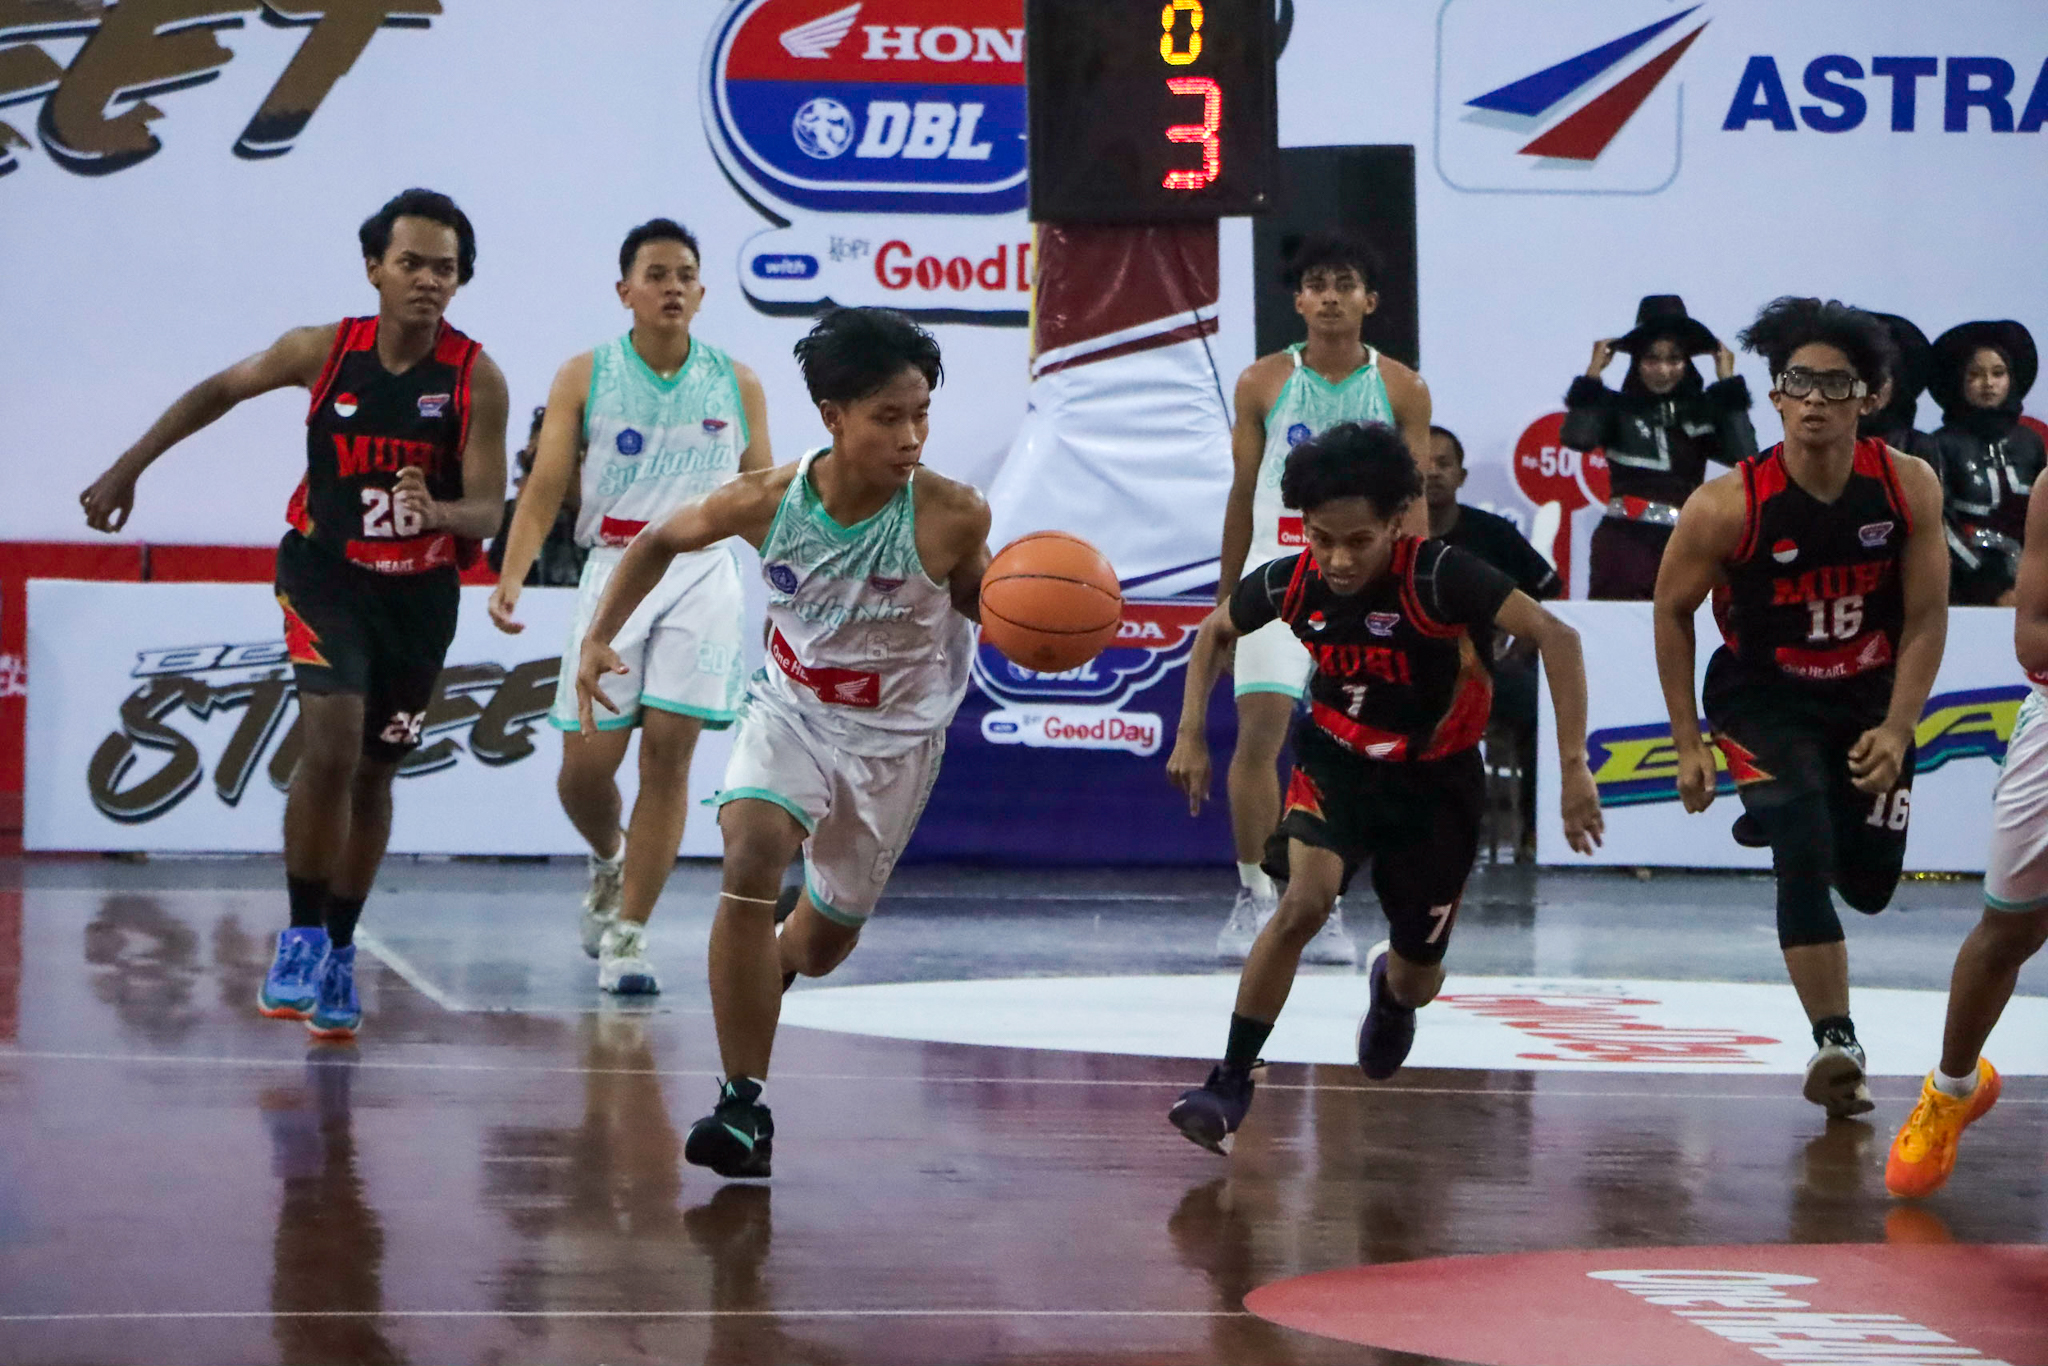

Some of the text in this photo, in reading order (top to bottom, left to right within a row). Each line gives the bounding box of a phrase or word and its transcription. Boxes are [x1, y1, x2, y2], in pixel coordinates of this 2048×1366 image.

[1160, 0, 1204, 65] 0
[855, 101, 993, 160] DBL
[1162, 77, 1222, 189] 3
[361, 487, 422, 537] 26
[1772, 560, 1894, 605] MUH
[1807, 595, 1864, 641] 16
[773, 644, 790, 669] One
[866, 630, 889, 660] 6
[1808, 662, 1846, 678] HEART
[1045, 716, 1104, 740] Good
[1109, 719, 1155, 748] Day
[1866, 787, 1911, 830] 16
[1426, 903, 1453, 944] 7
[1586, 1268, 1820, 1309] One
